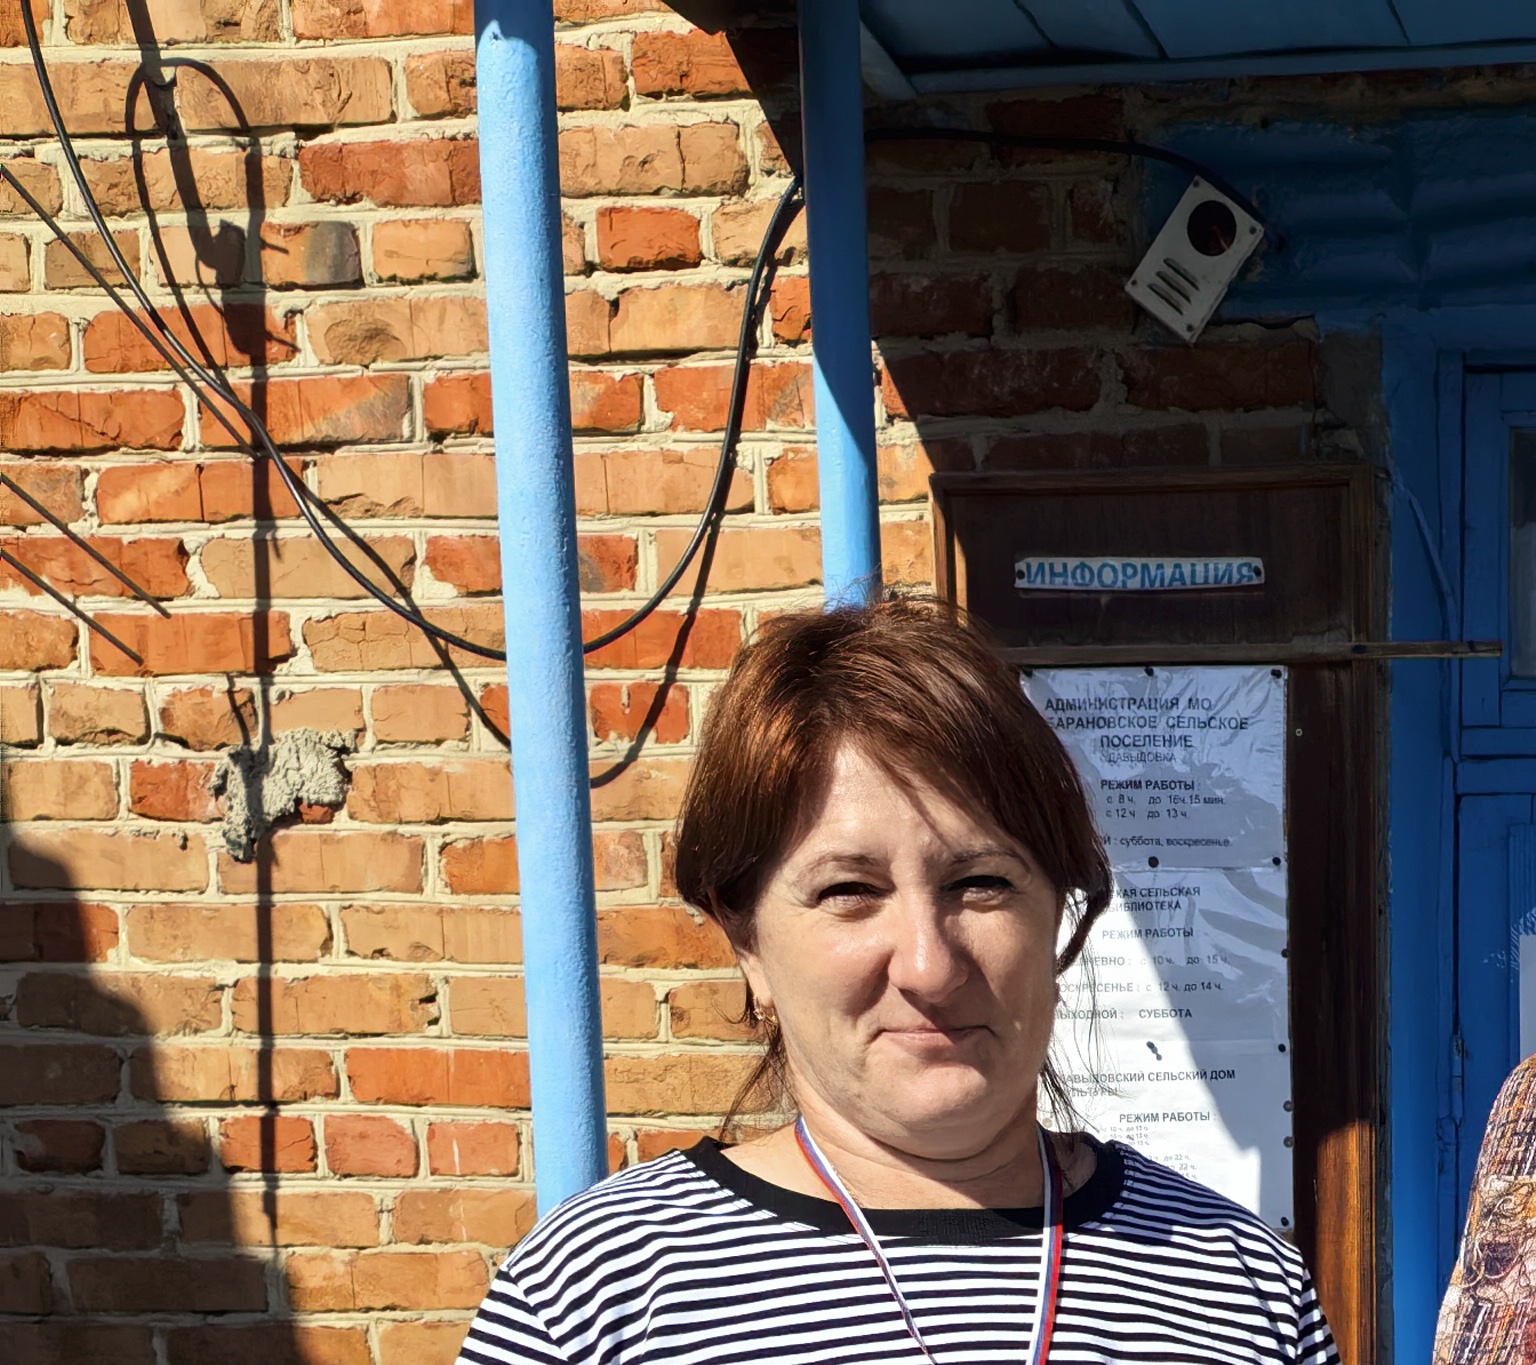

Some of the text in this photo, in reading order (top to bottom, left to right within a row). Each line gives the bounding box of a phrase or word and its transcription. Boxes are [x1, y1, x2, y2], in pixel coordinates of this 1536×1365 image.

[1026, 561, 1253, 589] ИНФОРМАЦИЯ
[1045, 697, 1213, 712] АДМИНИСТРАЦИЯ МО
[1166, 716, 1250, 730] СЕЛЬСКОЕ
[1100, 734, 1194, 749] ПОСЕЛЕНИЕ
[1100, 779, 1196, 791] РЕЖИМ РАБОТЫ
[1115, 808, 1127, 819] 12
[1166, 808, 1179, 819] 13
[1139, 886, 1201, 898] СЕЛЬСКАЯ
[1102, 926, 1194, 940] РЕЖИМ РАБОТЫ
[1186, 956, 1200, 967] до
[1184, 983, 1198, 994] до
[1201, 980, 1212, 992] 14
[1138, 1008, 1193, 1019] СУББОТА
[1147, 1069, 1208, 1083] СЕЛЬСКИЙ
[1209, 1069, 1236, 1082] ДОМ
[1119, 1110, 1210, 1124] РЕЖИМ РАБОТЫ
